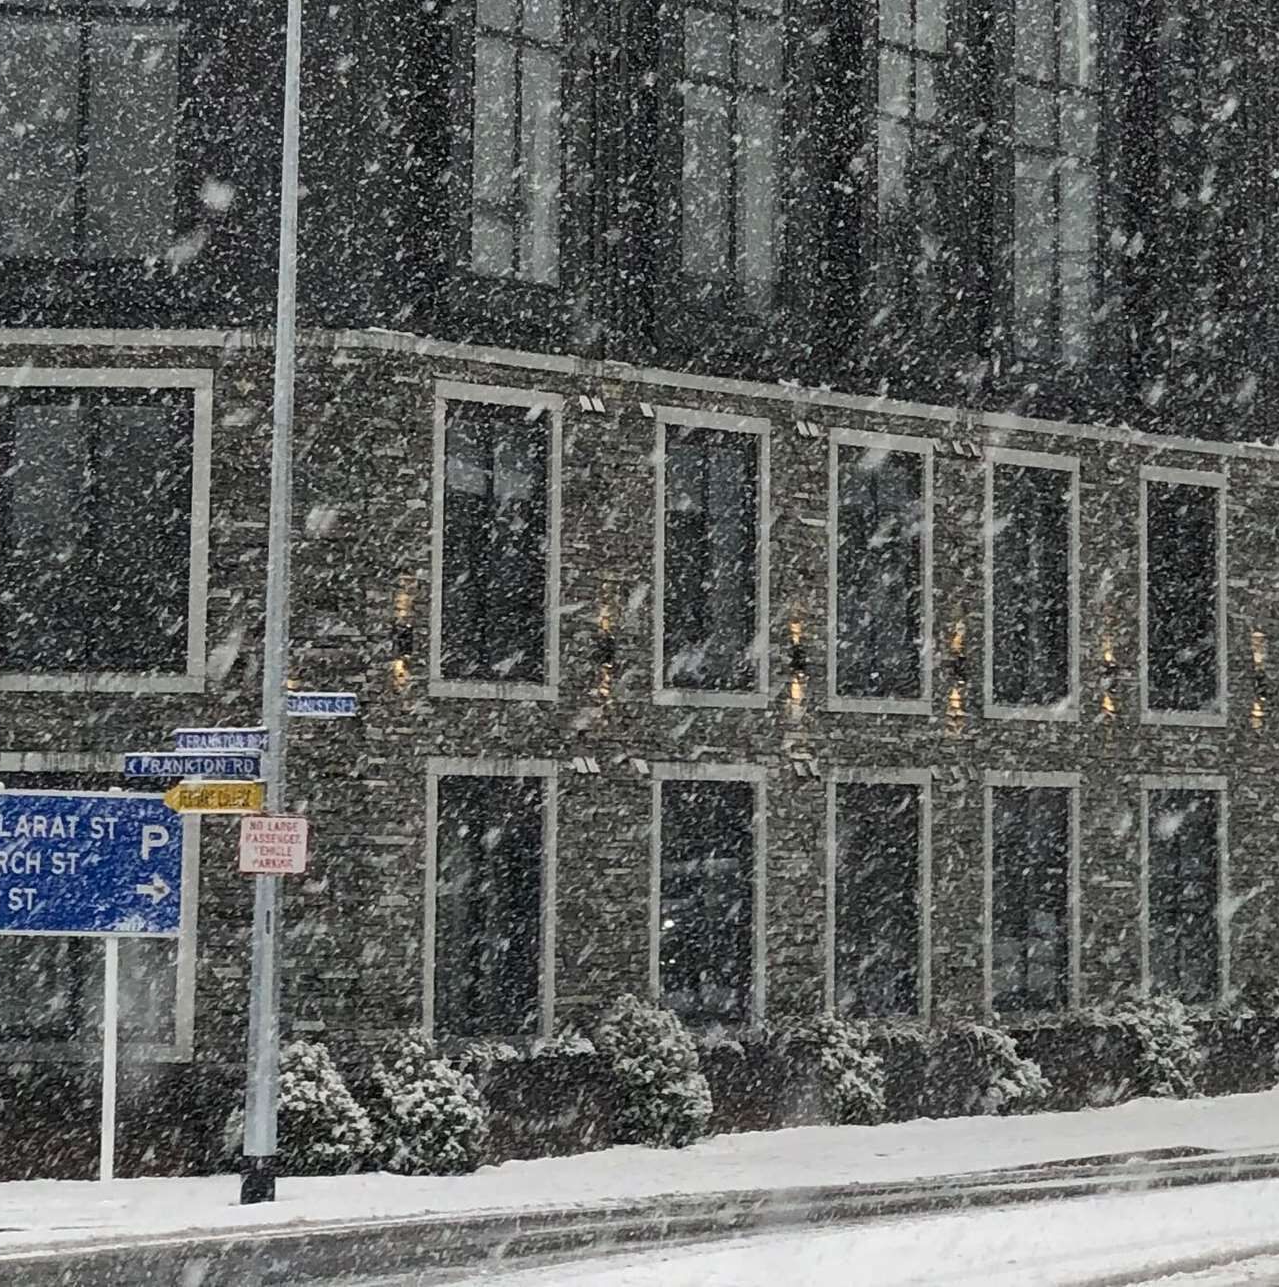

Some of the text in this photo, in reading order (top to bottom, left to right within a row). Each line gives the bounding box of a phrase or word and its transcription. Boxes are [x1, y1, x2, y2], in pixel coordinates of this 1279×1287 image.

[141, 757, 255, 773] FRANKTON RD
[90, 816, 119, 839] ST
[250, 821, 298, 832] NO LARGE
[141, 825, 169, 860] P
[51, 852, 80, 875] ST
[8, 887, 37, 911] ST
